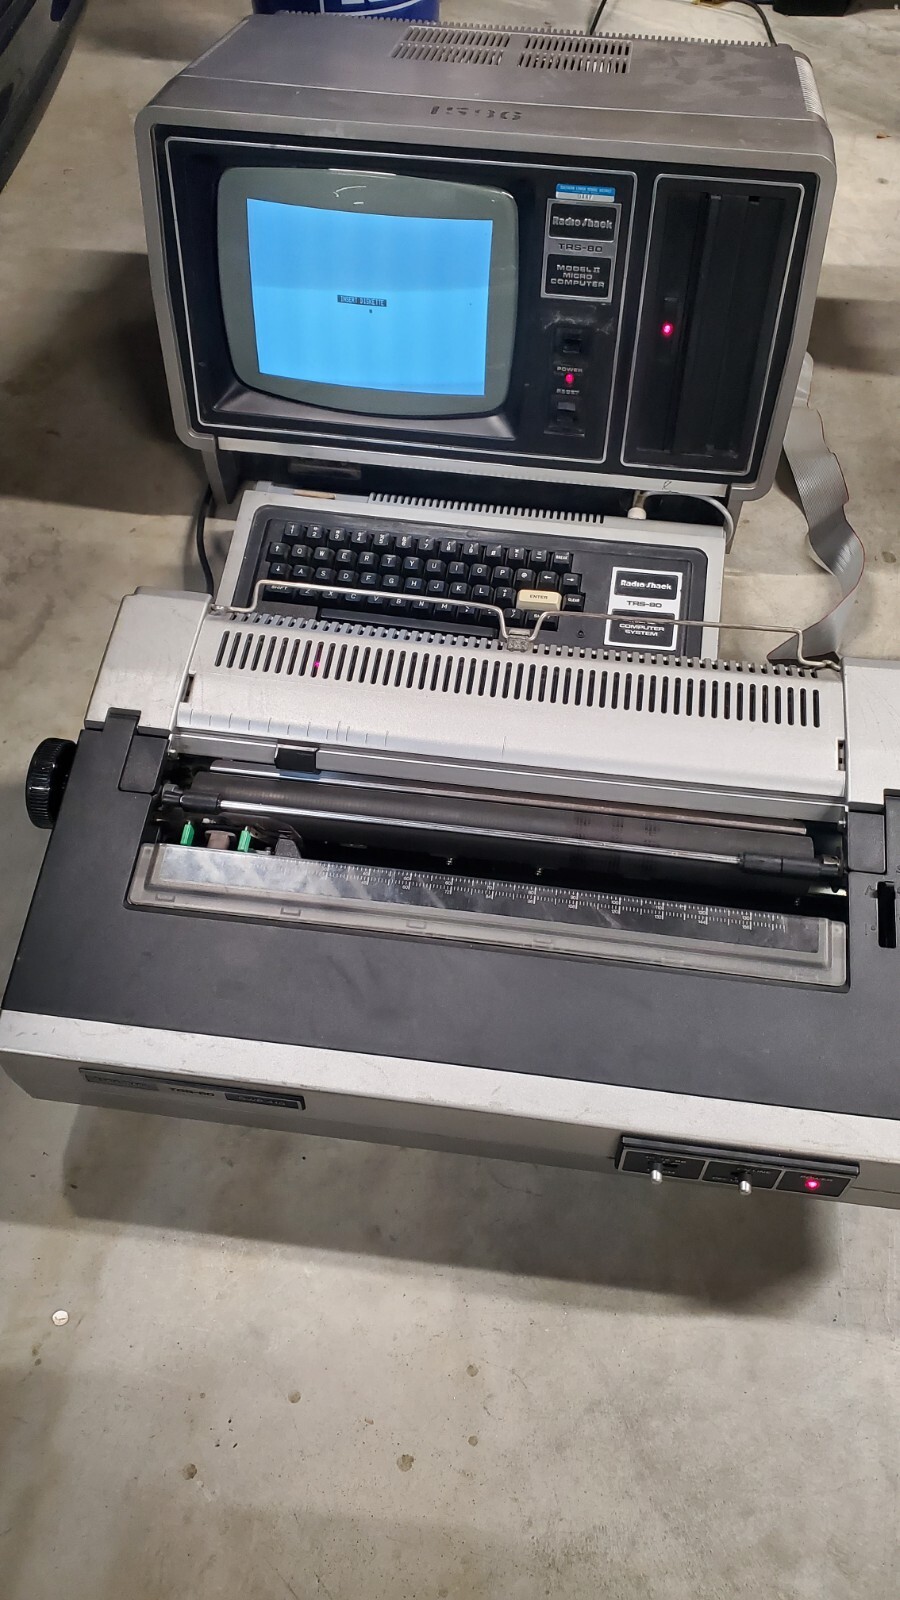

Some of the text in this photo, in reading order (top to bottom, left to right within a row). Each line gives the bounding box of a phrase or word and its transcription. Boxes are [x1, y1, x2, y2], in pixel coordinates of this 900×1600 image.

[552, 215, 613, 229] Radio Shack
[558, 243, 603, 253] TRS-80
[551, 278, 604, 288] COMPUTER
[621, 580, 672, 590] Radio Shack
[627, 600, 662, 608] TRS-80
[619, 623, 665, 631] COMPUTER
